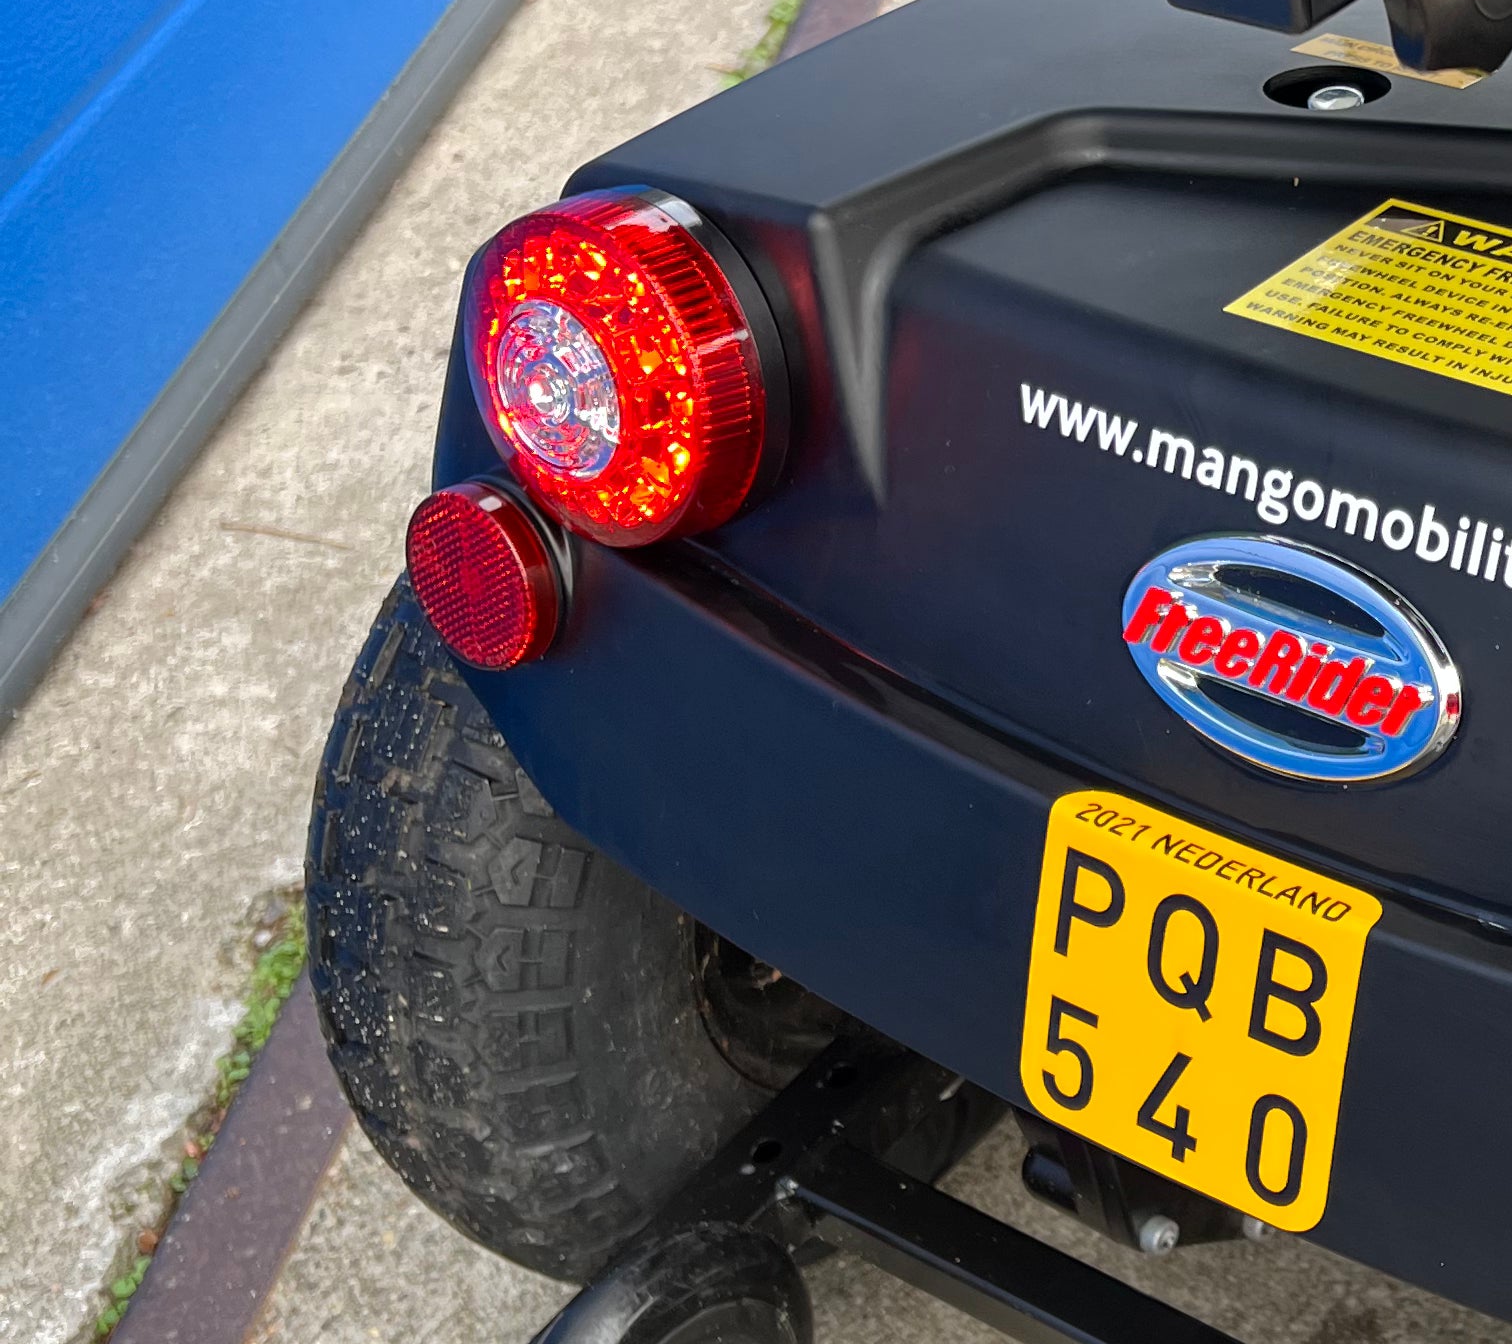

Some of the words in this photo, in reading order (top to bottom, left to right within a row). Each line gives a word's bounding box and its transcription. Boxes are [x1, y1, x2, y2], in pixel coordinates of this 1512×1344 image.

[1334, 244, 1394, 265] NEVER
[1395, 261, 1427, 273] SIT
[1428, 270, 1456, 282] ON
[1459, 277, 1509, 296] YOUR
[1347, 230, 1486, 273] EMERGENCY
[1281, 278, 1392, 313] EMERGENCY
[1392, 310, 1501, 346] FREEWHEEL
[1307, 302, 1384, 328] FAILURE
[1385, 324, 1410, 336] TO
[1412, 332, 1488, 357] COMPLY
[1390, 293, 1463, 317] ALWAYS
[1421, 284, 1490, 307] DEVICE
[1491, 303, 1512, 314] IN
[1245, 302, 1330, 331] WARNING
[1331, 326, 1374, 342] MAY
[1372, 338, 1445, 363] RESULT
[1445, 360, 1469, 371] IN
[1122, 585, 1428, 738] FreeRider
[1074, 802, 1152, 842] 2021
[1151, 833, 1352, 922] NEDERLAND
[1053, 846, 1329, 1057] PQB
[1041, 994, 1308, 1207] 540
